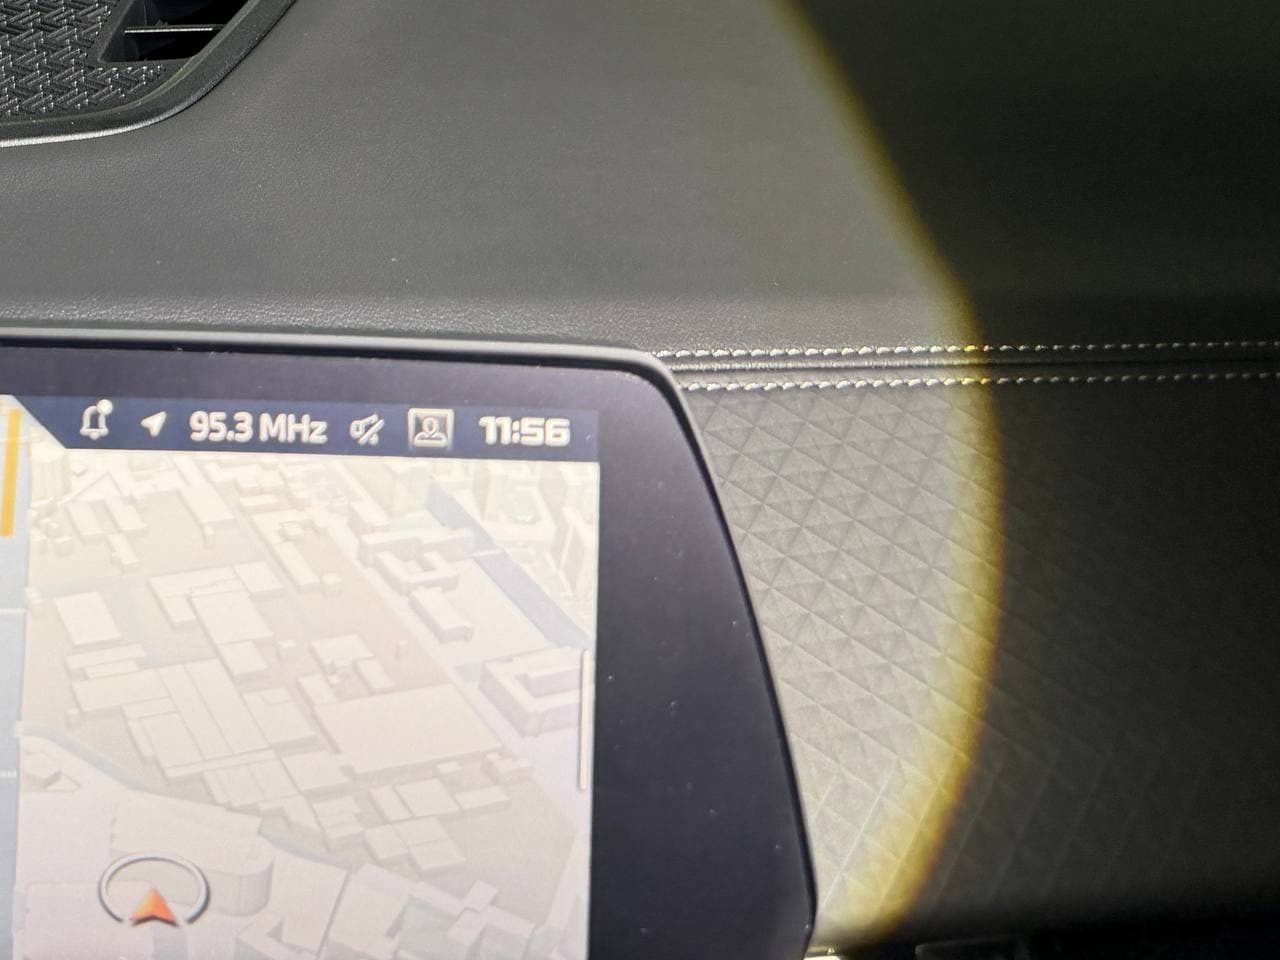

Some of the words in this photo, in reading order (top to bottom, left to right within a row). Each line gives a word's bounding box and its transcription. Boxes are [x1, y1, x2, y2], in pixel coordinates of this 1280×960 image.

[189, 410, 254, 442] 95.3
[258, 413, 328, 444] MHz
[478, 415, 571, 447] 11:56
